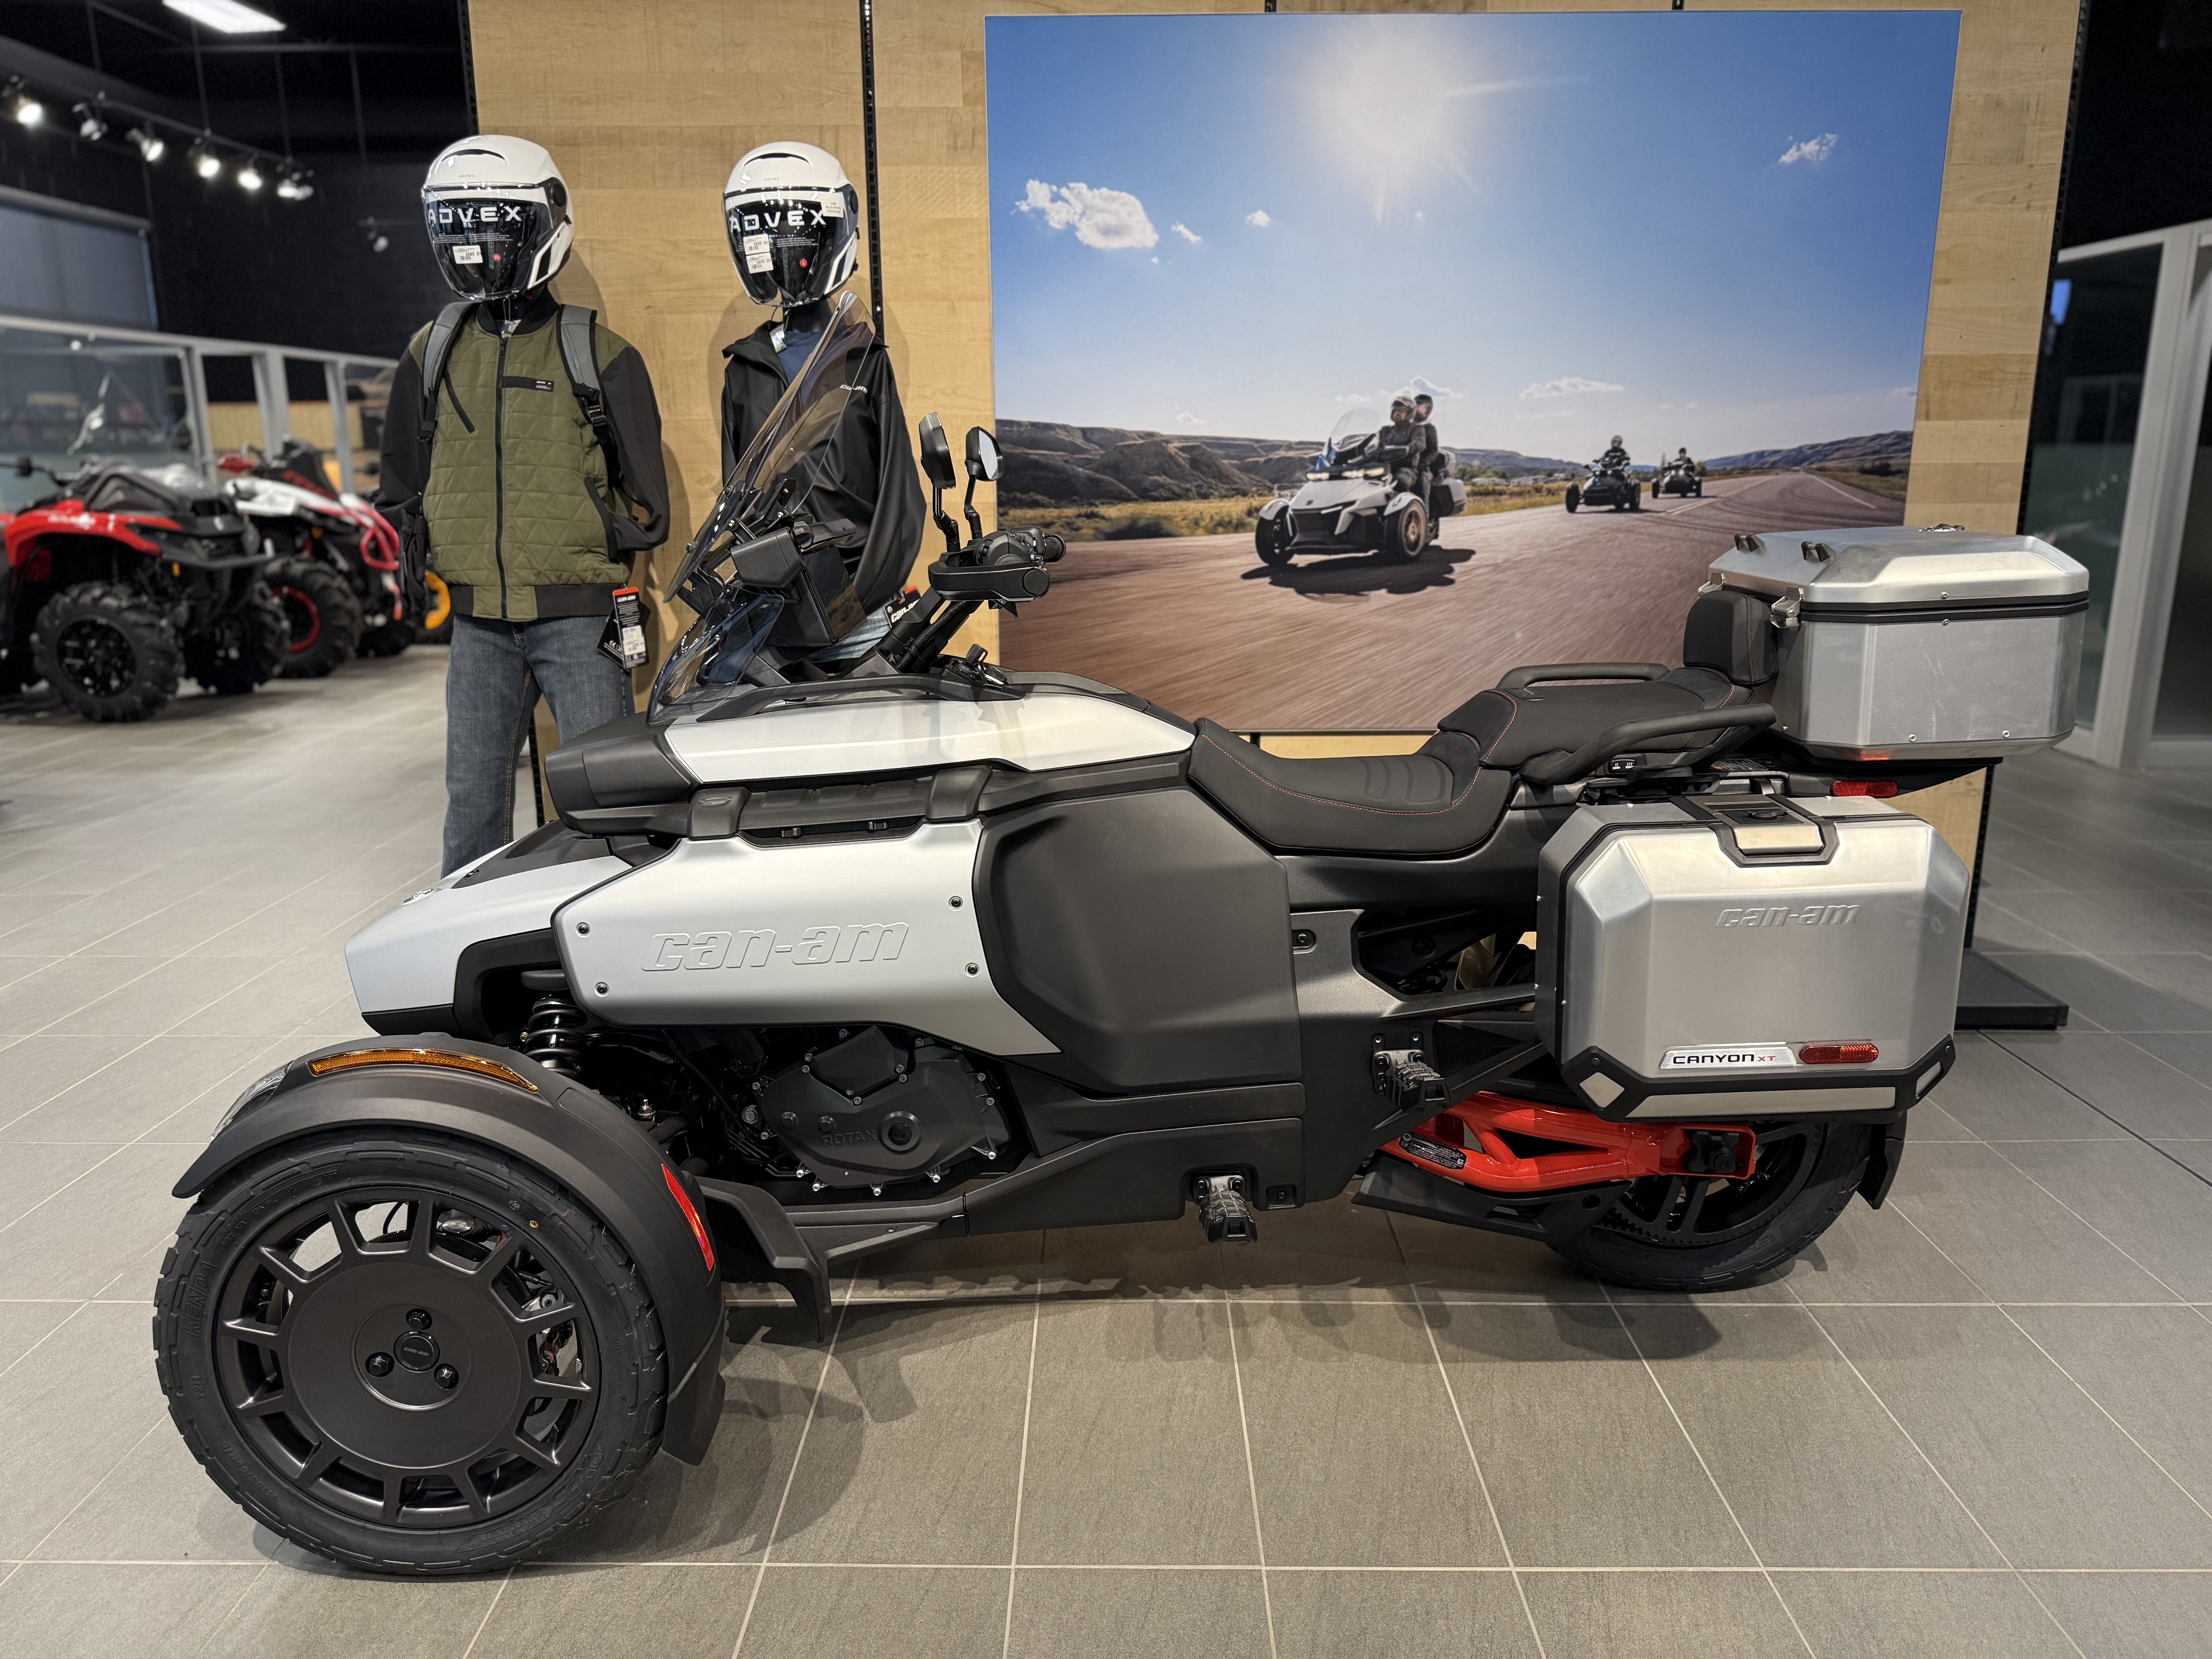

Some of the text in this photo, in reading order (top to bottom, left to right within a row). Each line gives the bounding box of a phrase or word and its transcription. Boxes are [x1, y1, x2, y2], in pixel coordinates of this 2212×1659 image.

[428, 206, 522, 223] ADVEX
[729, 210, 826, 233] ADVEX
[1716, 904, 1860, 929] can-am
[641, 921, 909, 972] can-am
[1673, 1053, 1755, 1065] CANYON
[821, 1130, 878, 1147] ROTAX
[182, 1261, 218, 1337] KENDA
[404, 1347, 429, 1356] can-am
